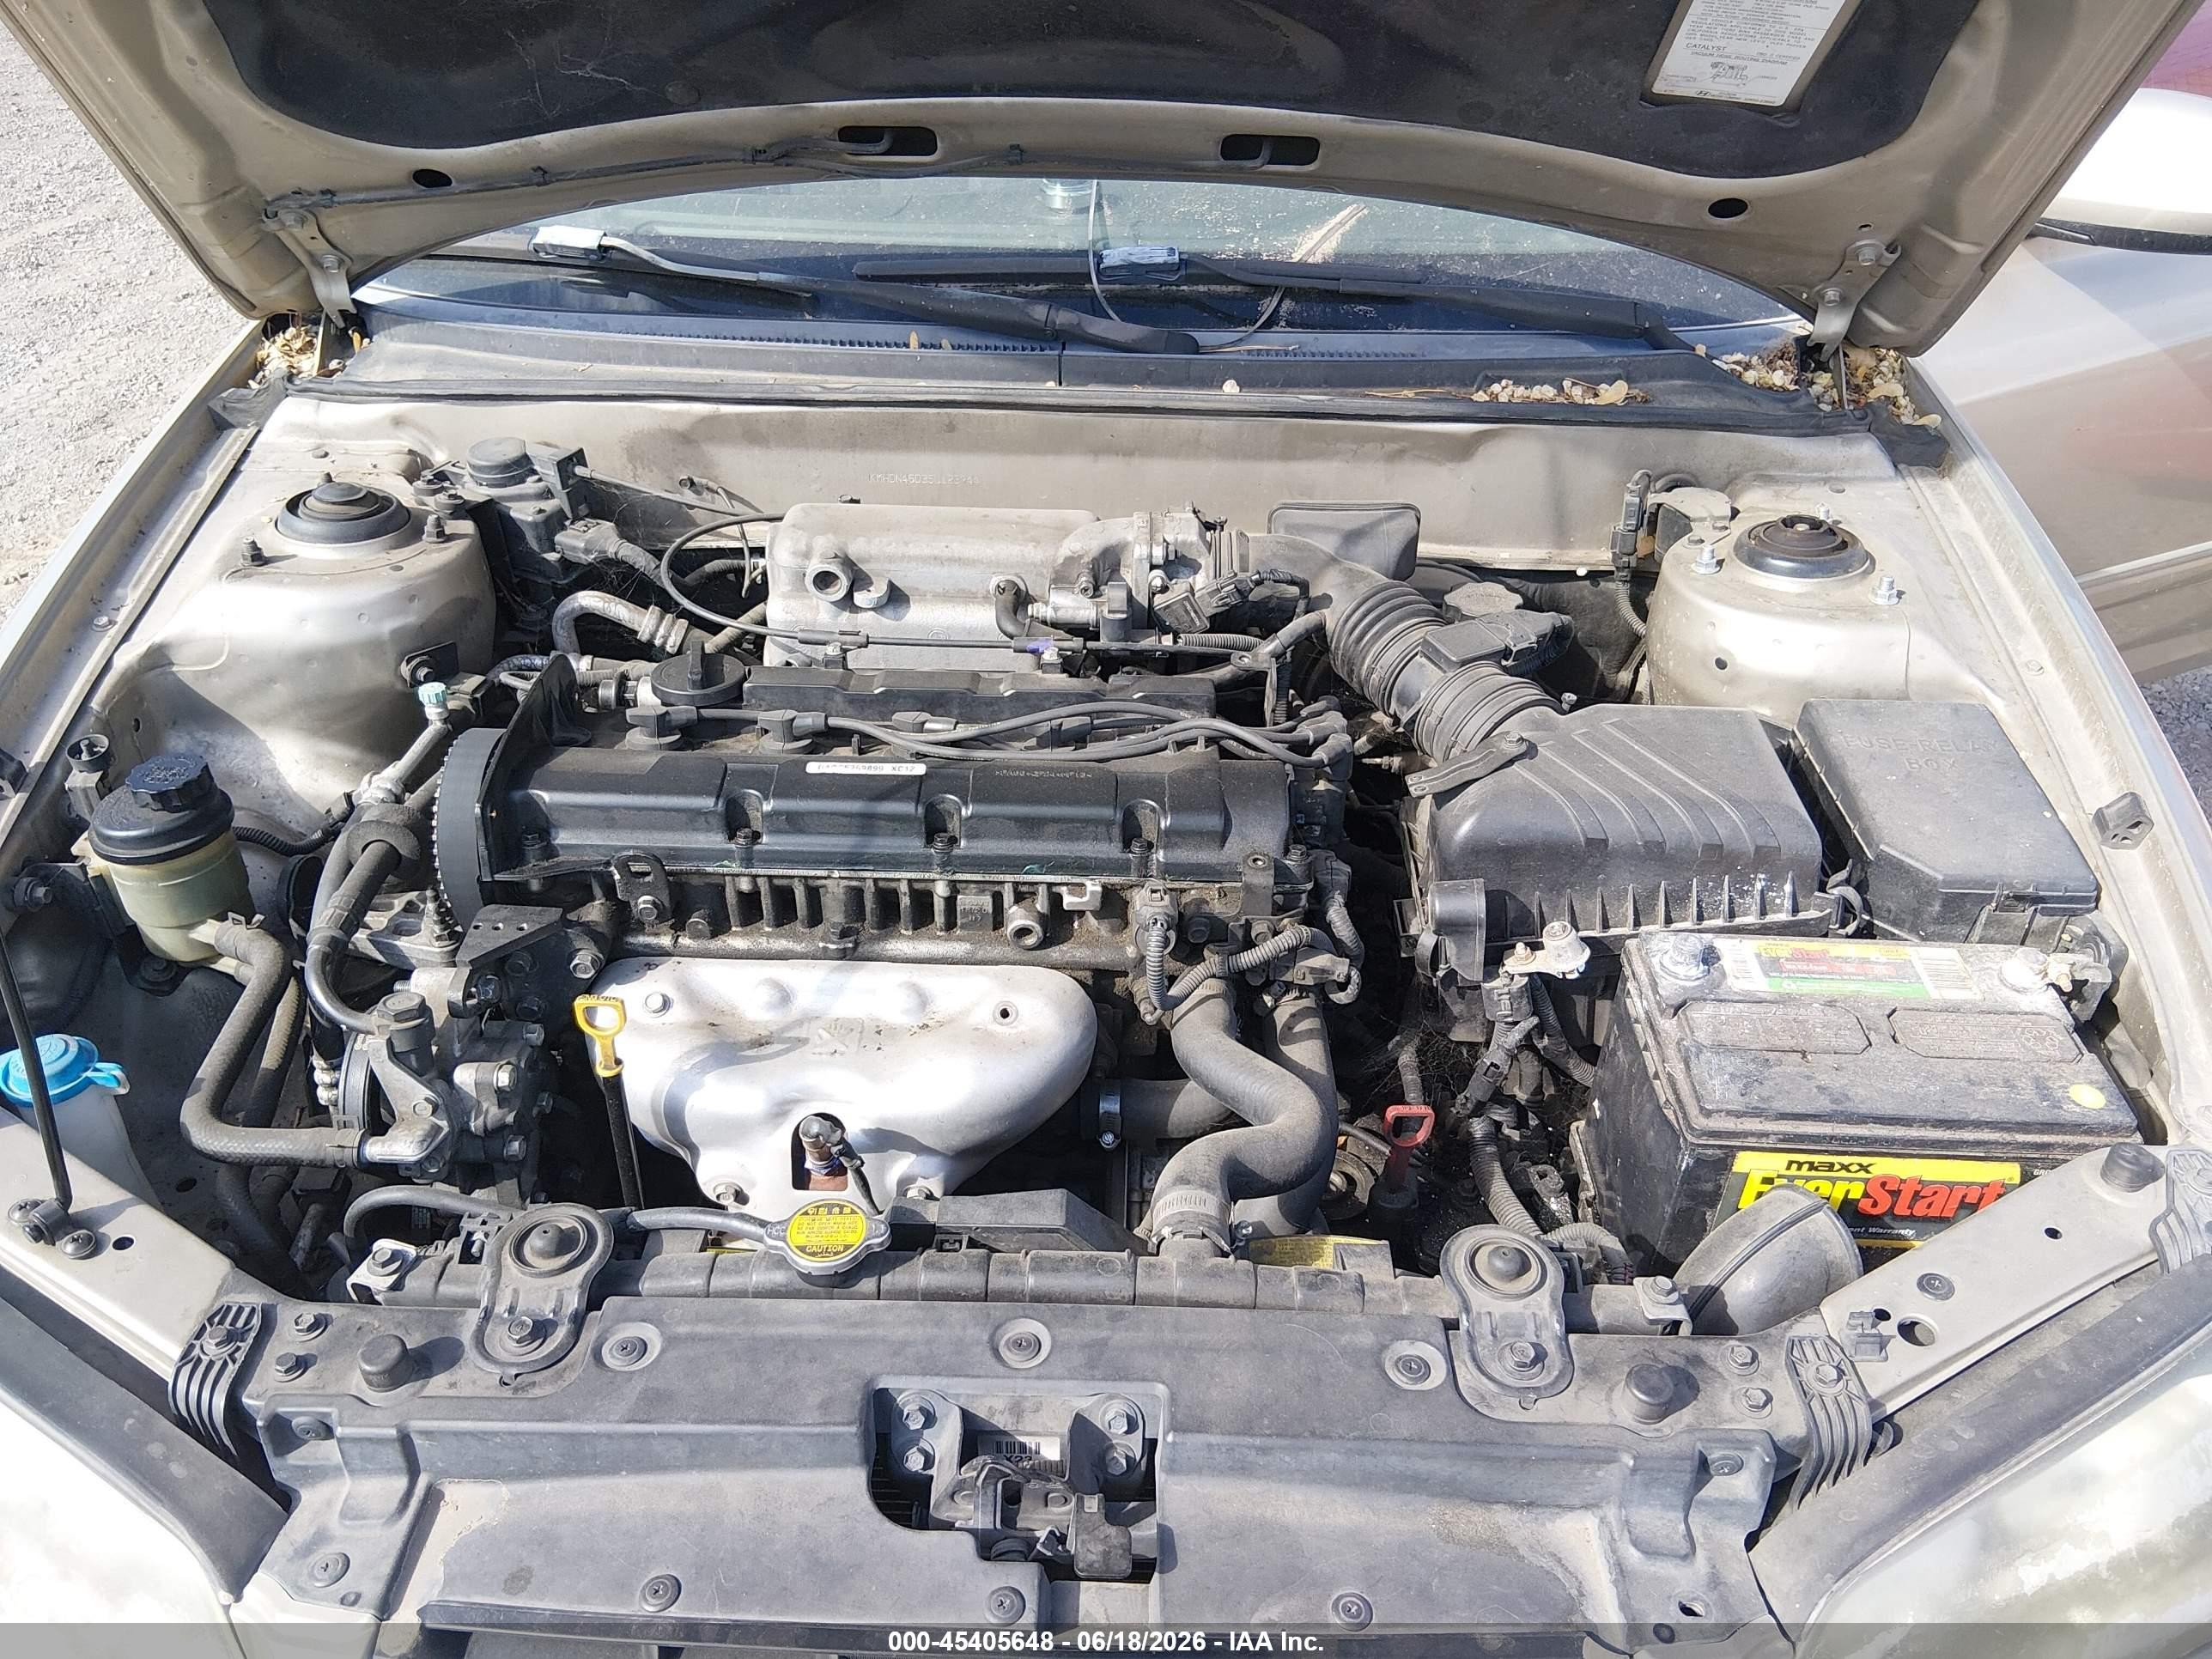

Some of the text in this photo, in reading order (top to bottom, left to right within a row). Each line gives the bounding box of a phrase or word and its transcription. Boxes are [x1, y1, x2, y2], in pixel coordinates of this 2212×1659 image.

[1686, 42, 1727, 52] CATALYST
[1843, 735, 1999, 754] FUSE-RELAY
[1904, 757, 1959, 771] BOX
[1784, 1159, 1877, 1175] maxx
